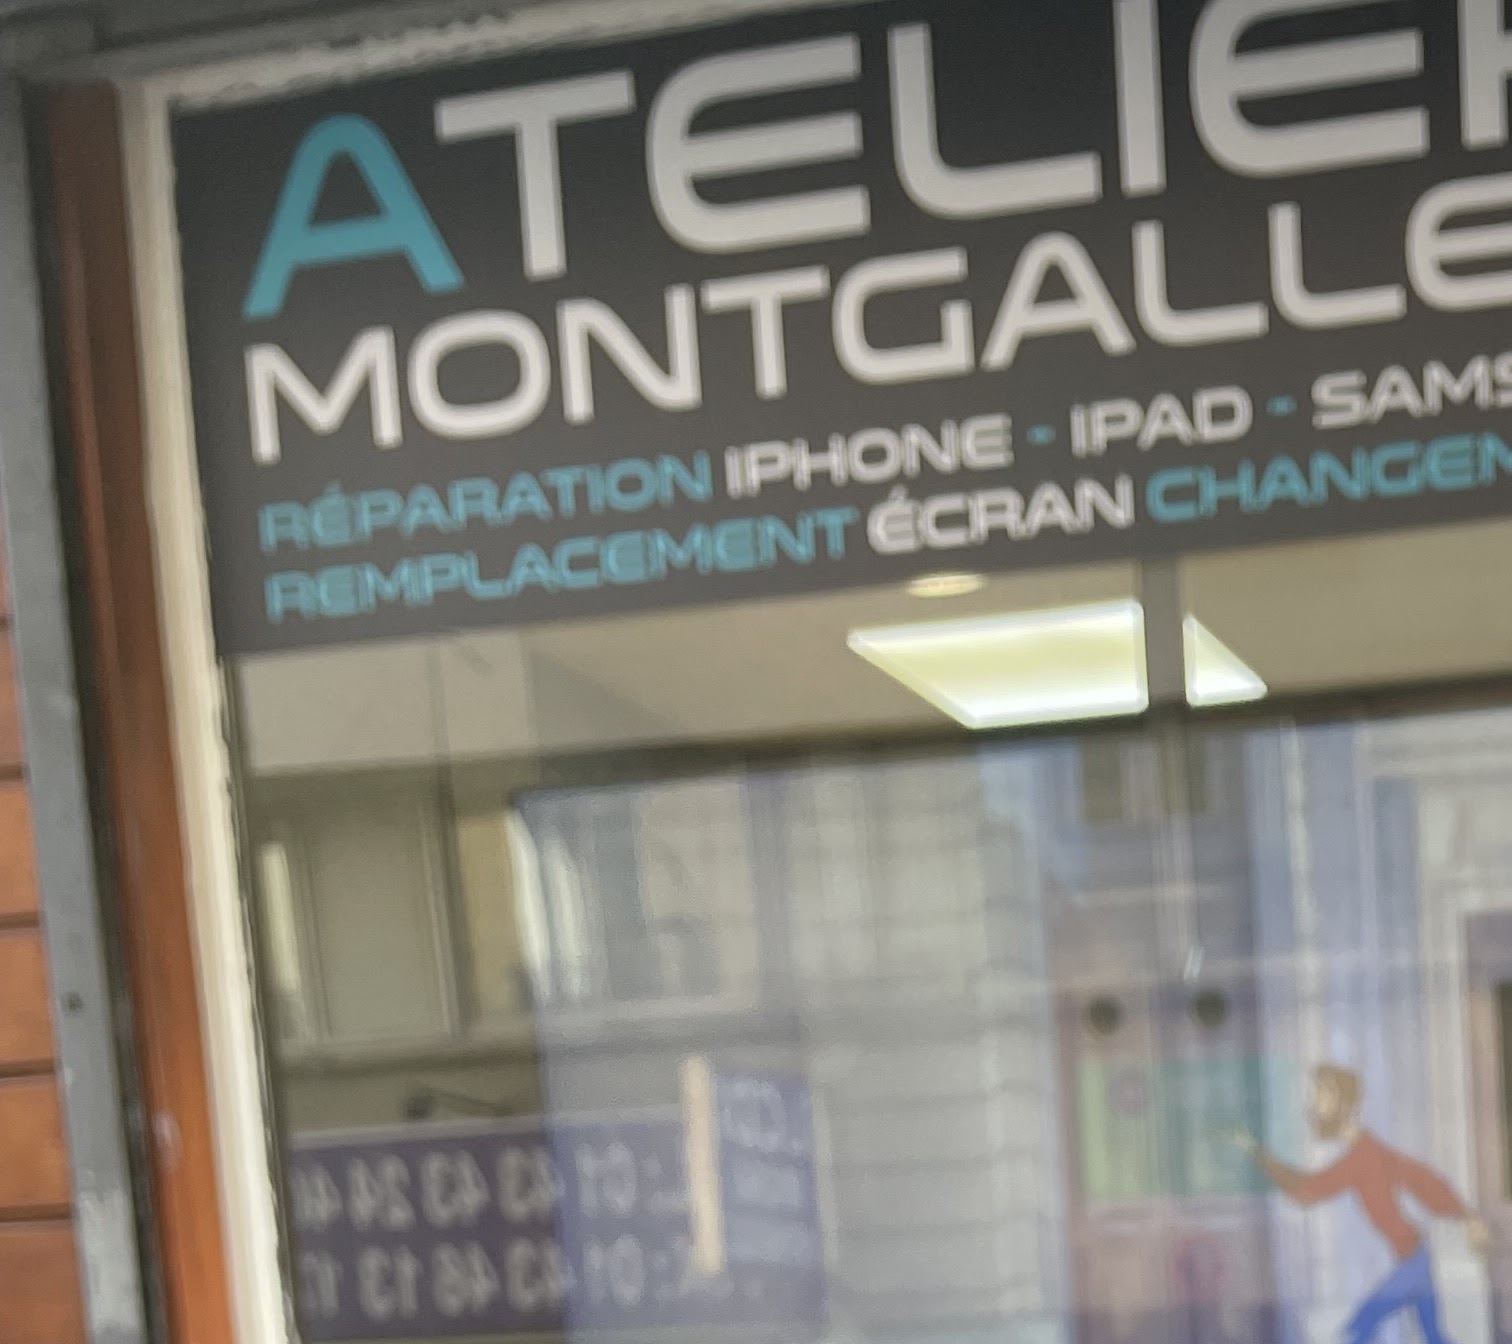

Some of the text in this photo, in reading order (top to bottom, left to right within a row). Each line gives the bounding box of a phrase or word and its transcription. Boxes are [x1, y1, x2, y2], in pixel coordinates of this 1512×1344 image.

[259, 449, 713, 555] RÉPARATION
[725, 412, 1014, 499] IPHONE
[1069, 384, 1253, 458] IPAD
[264, 505, 860, 625] REMPLACEMENT
[867, 472, 1135, 555] ÉCRAN
